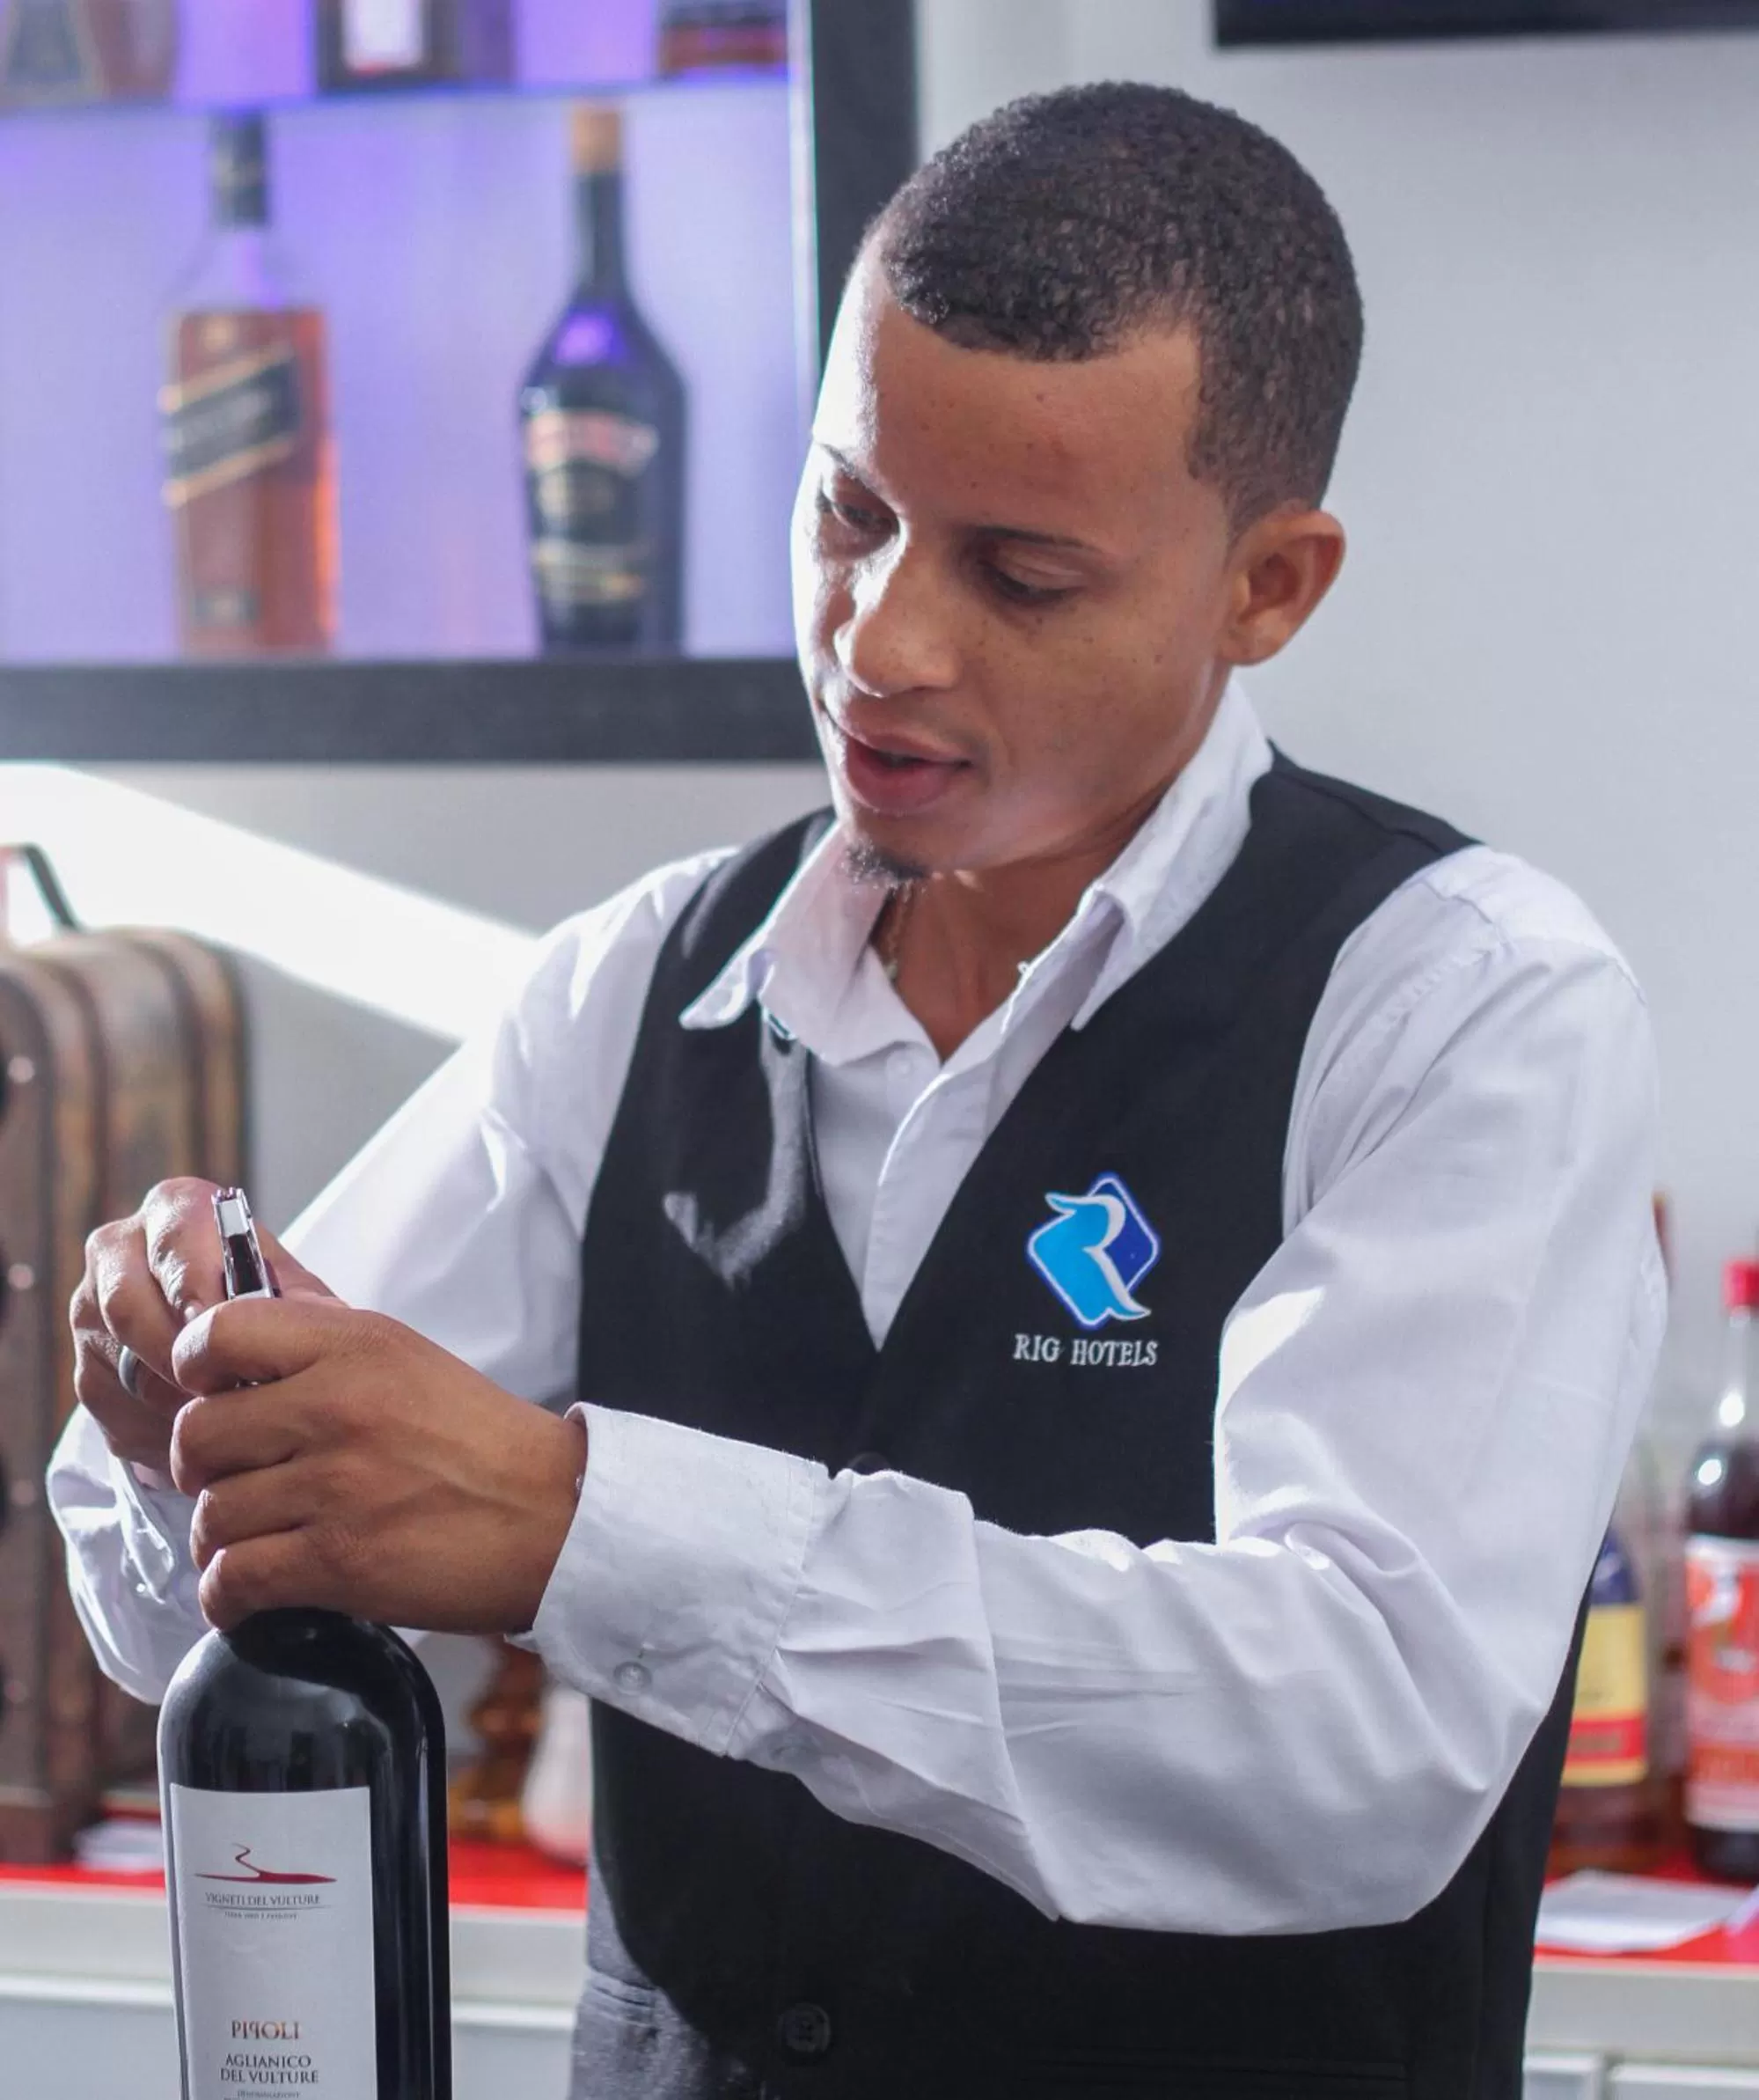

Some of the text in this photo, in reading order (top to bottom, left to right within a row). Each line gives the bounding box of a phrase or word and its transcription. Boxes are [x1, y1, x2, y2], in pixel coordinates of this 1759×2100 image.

[1014, 1333, 1158, 1366] RIG HOTELS
[204, 1892, 320, 1906] VIGNETI DEL VULTURE
[225, 2053, 311, 2067] AGLIANICO
[220, 2067, 319, 2084] DEL VULTURE
